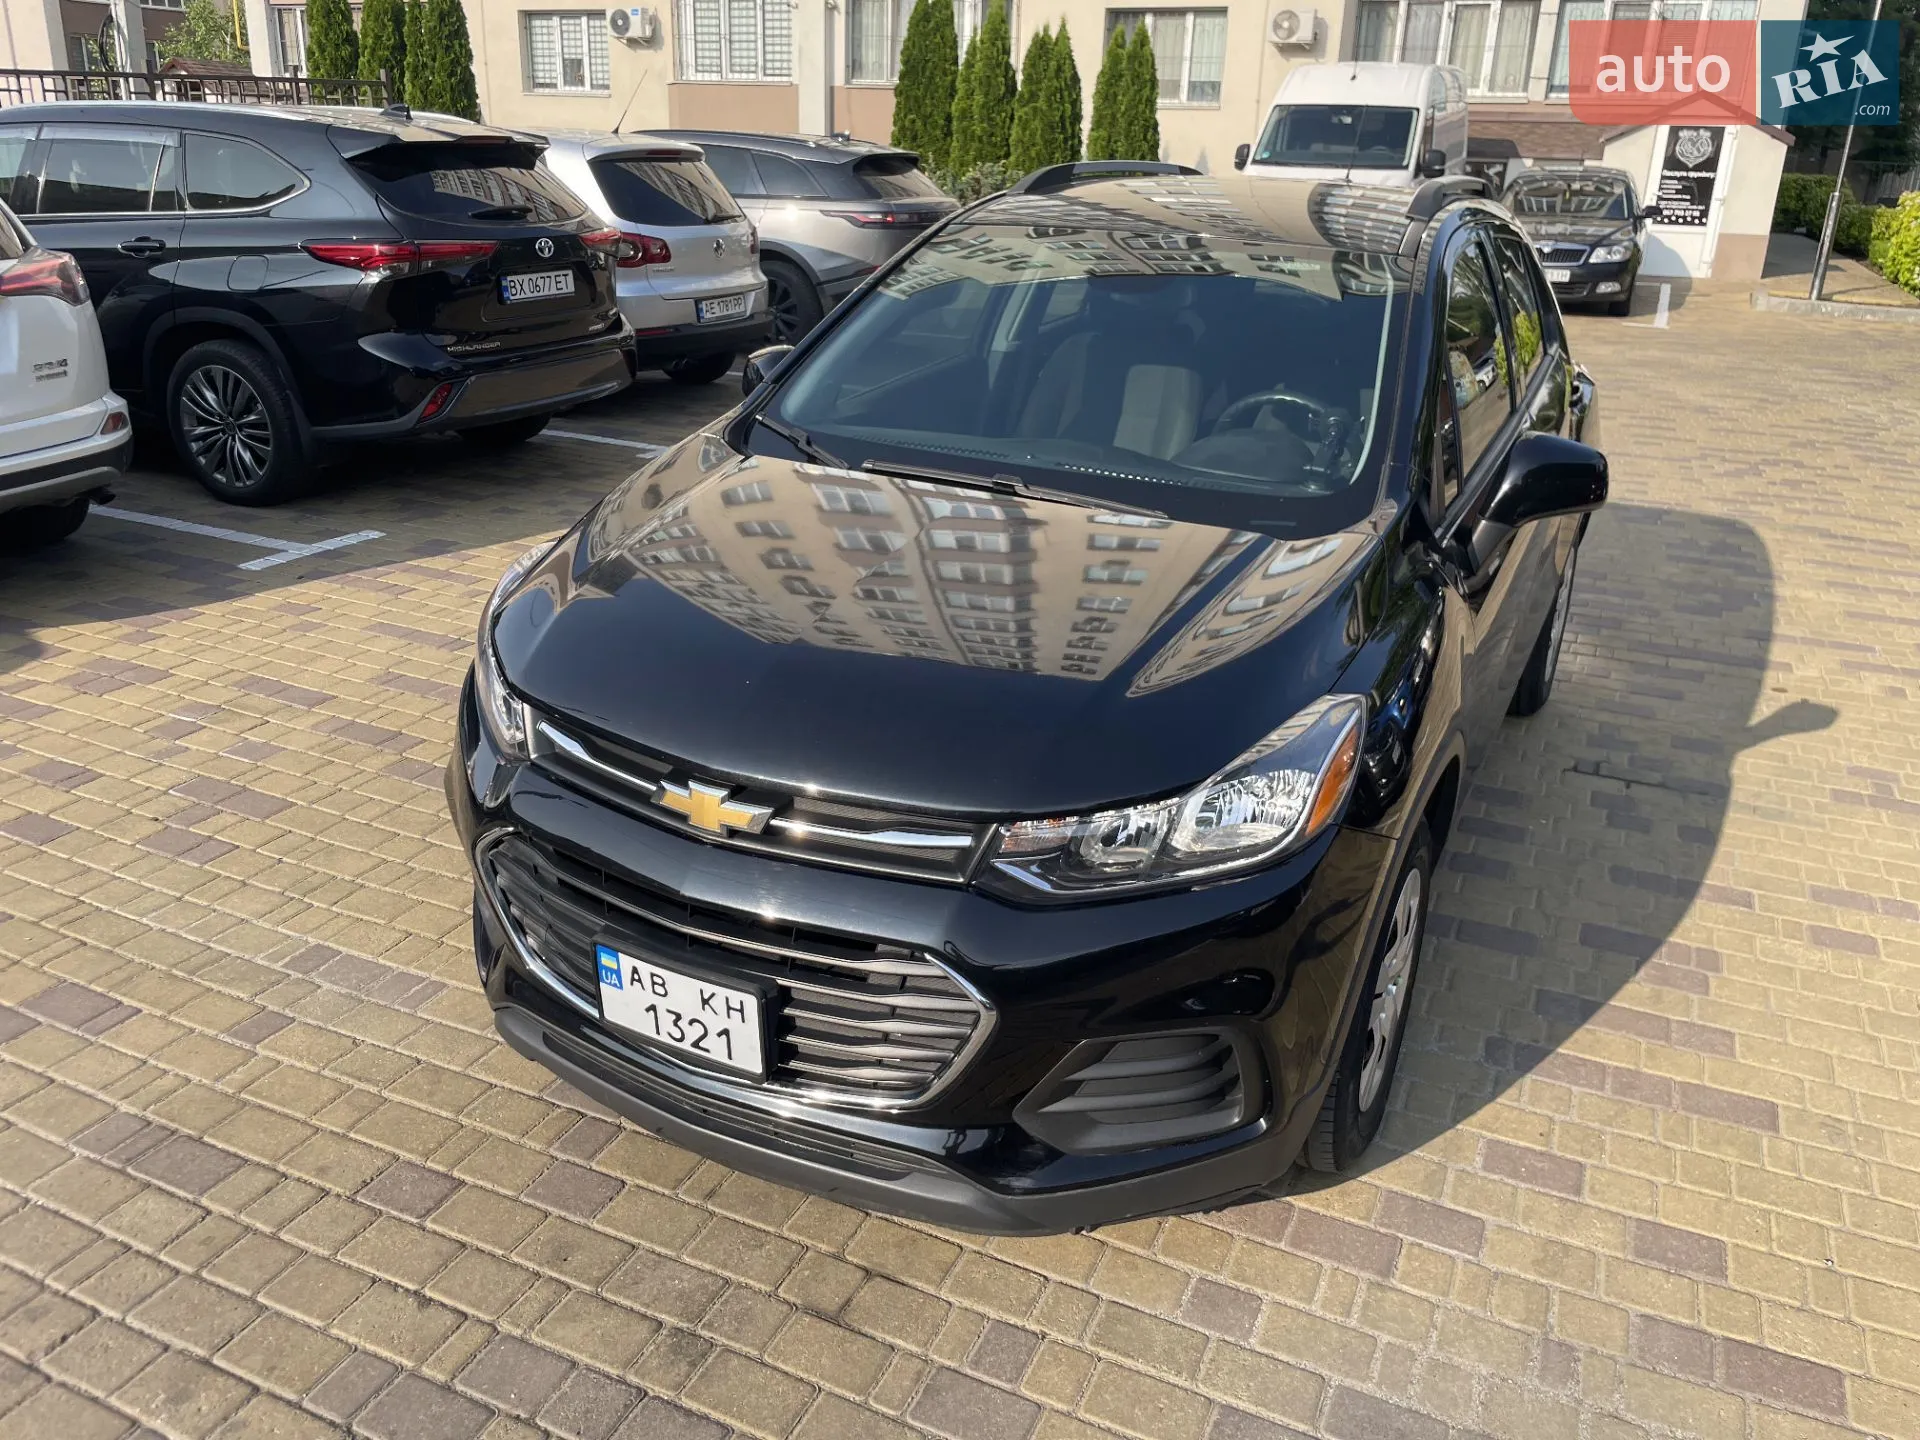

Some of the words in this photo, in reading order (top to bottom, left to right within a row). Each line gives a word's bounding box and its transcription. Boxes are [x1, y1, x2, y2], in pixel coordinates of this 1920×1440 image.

[509, 278, 526, 297] BX
[528, 275, 552, 294] 0677
[555, 273, 569, 291] ET
[705, 301, 716, 316] AE
[602, 969, 620, 987] UA
[629, 965, 668, 998] AB
[700, 988, 745, 1023] KH
[644, 1003, 732, 1060] 1321
